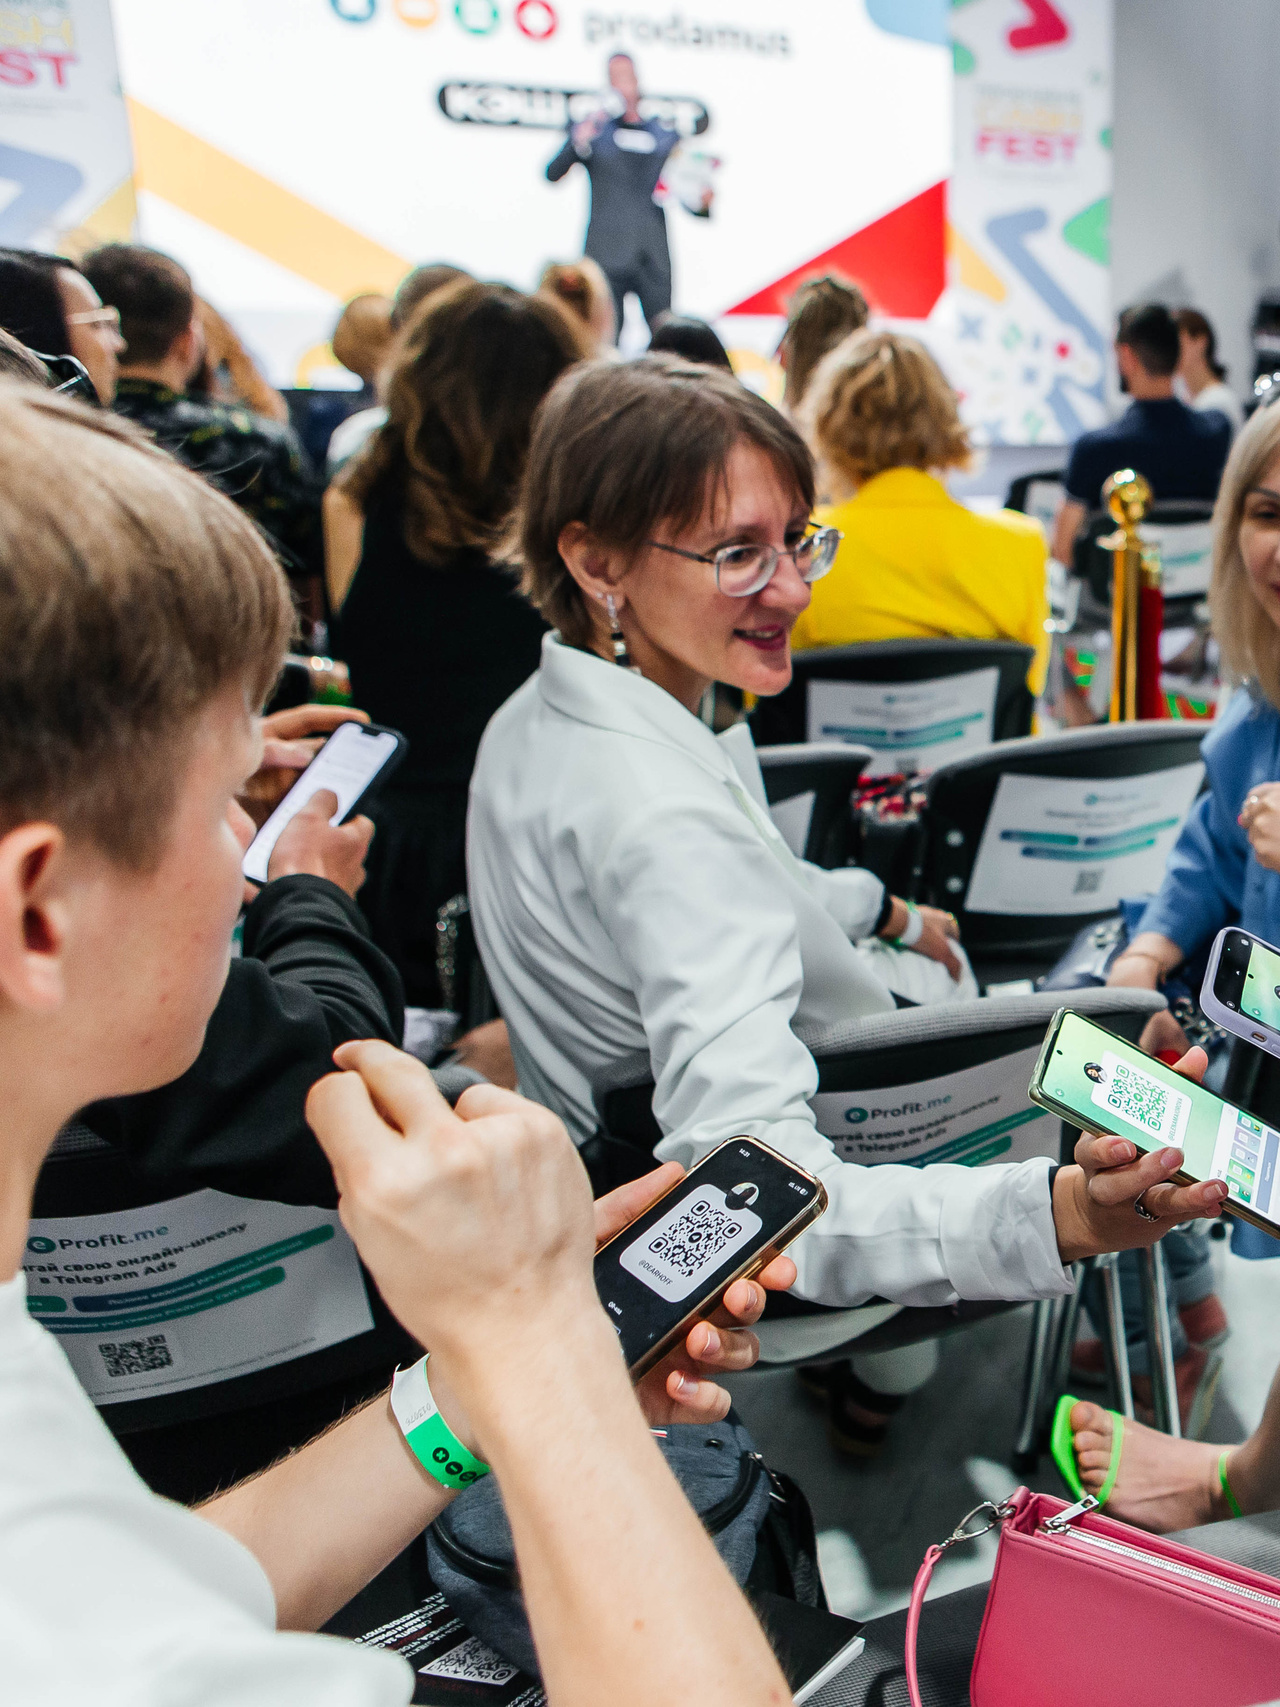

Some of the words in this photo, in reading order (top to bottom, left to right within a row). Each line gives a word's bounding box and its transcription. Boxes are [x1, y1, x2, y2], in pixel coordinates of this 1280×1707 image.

[584, 10, 790, 53] prodamus
[0, 49, 79, 90] ST
[976, 132, 1078, 163] FEST
[857, 1138, 922, 1153] Telegram
[58, 1226, 169, 1250] Profit.me
[63, 1261, 112, 1272] свою
[117, 1223, 248, 1268] онлайн-школу
[54, 1271, 139, 1285] Telegram
[143, 1261, 178, 1276] Ads
[638, 1259, 673, 1286] @DEARHOFF
